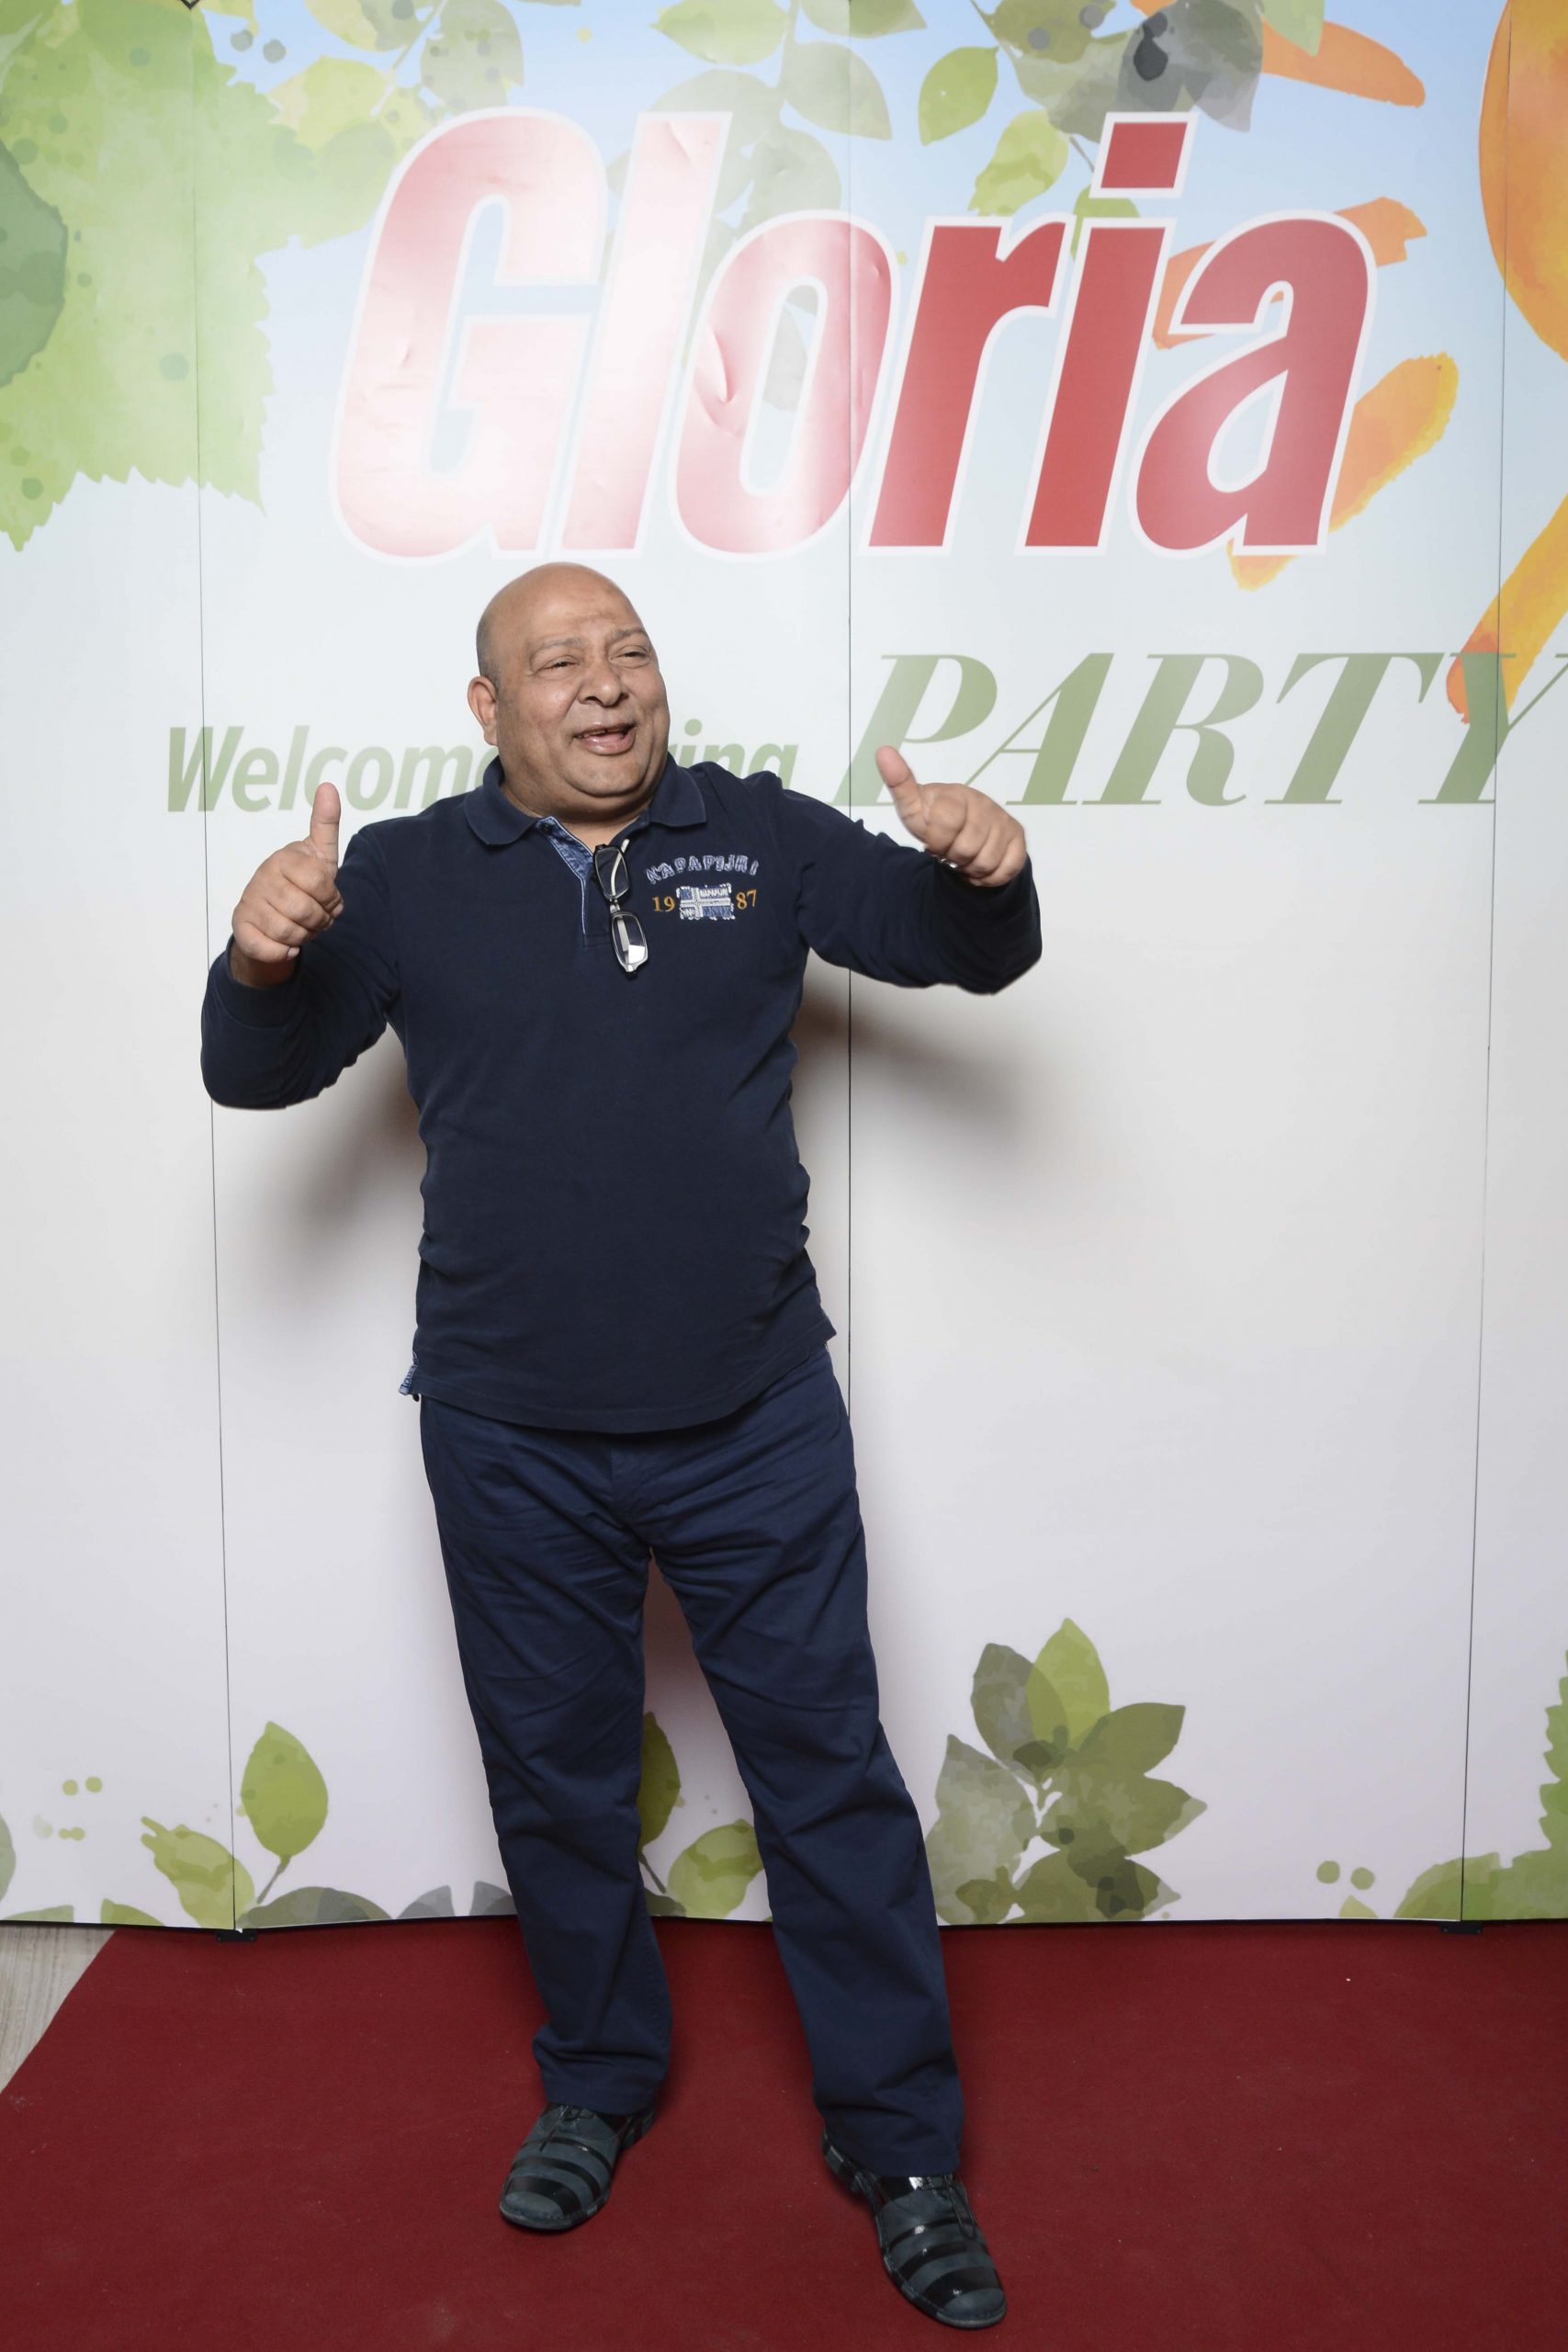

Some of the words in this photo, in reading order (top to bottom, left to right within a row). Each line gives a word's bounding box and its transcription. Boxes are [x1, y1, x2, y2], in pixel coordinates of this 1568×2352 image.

[331, 107, 1378, 563] Gloria
[167, 725, 500, 812] Welcom
[826, 652, 1568, 808] PARTY
[652, 896, 676, 912] 19
[736, 889, 757, 910] 87
